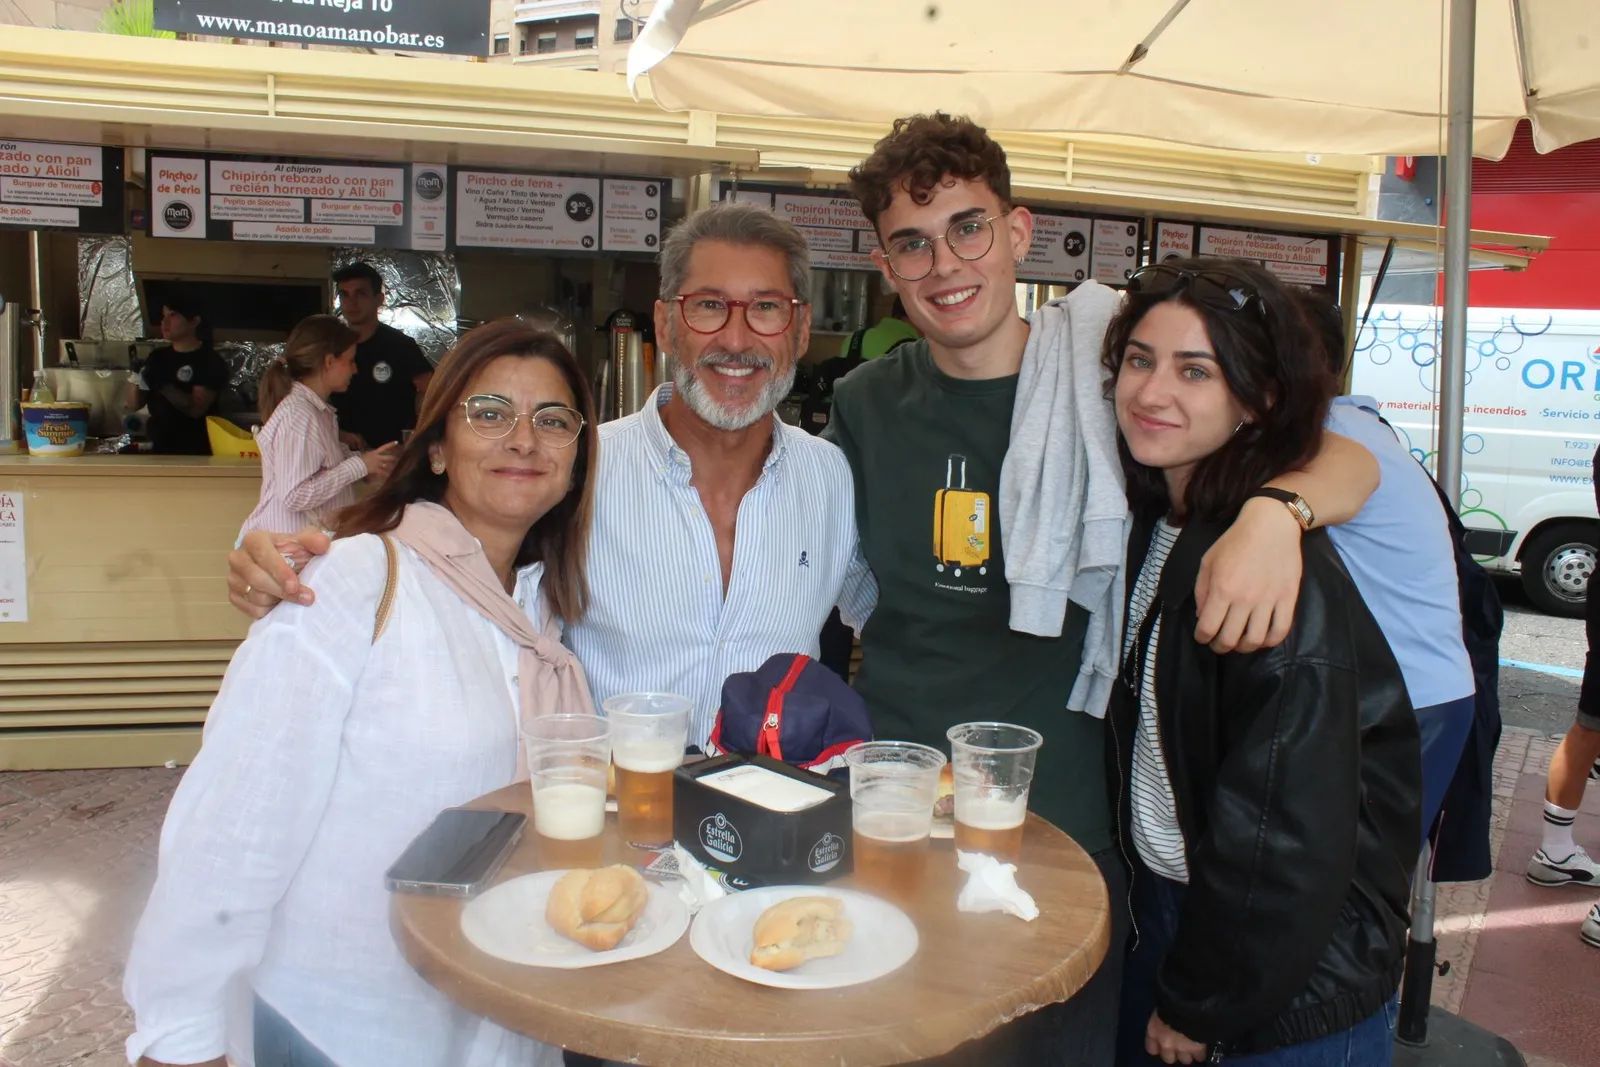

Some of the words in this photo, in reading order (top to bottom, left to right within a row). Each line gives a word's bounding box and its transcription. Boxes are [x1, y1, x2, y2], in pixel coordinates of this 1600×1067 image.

[197, 14, 445, 48] www.manoamanobar.es
[36, 154, 62, 163] con
[67, 156, 92, 167] pan
[34, 166, 41, 176] y
[46, 165, 80, 177] Alioli
[274, 164, 284, 172] Al
[286, 165, 322, 174] chipirón
[159, 169, 198, 183] Pinchos
[221, 170, 276, 182] Chipirón
[281, 172, 339, 185] rebozado
[344, 175, 367, 186] con
[371, 177, 394, 189] pan
[467, 174, 507, 187] Pincho
[510, 176, 525, 187] de
[528, 177, 553, 189] feria
[157, 184, 170, 193] de
[230, 183, 270, 193] recién
[274, 183, 335, 196] horneado
[338, 188, 345, 198] y
[350, 187, 365, 197] Ali
[369, 188, 386, 198] Oli
[479, 197, 496, 205] Agua
[530, 199, 556, 207] Verdejo
[784, 202, 830, 215] Chipirón
[10, 207, 32, 216] pollo
[484, 205, 515, 213] Refresco
[791, 216, 824, 225] recién
[275, 224, 300, 233] Asado
[301, 225, 312, 233] de
[313, 226, 332, 235] pollo
[1162, 228, 1188, 240] Pinchos
[1207, 235, 1243, 247] Chipirón
[1245, 239, 1285, 251] rebozado
[1287, 243, 1303, 252] con
[1305, 245, 1321, 255] pan
[1214, 245, 1241, 256] recién
[1242, 249, 1283, 260] horneado
[1285, 253, 1290, 262] y
[1292, 253, 1313, 263] Alioli
[1387, 401, 1432, 411] material
[1473, 404, 1527, 417] incendios
[1551, 458, 1593, 468] INFO@E
[0, 494, 15, 508] ÍA
[706, 823, 735, 844] Estrella
[706, 835, 734, 855] Galicia
[815, 842, 839, 857] Estrella
[815, 851, 838, 866] Galicia
